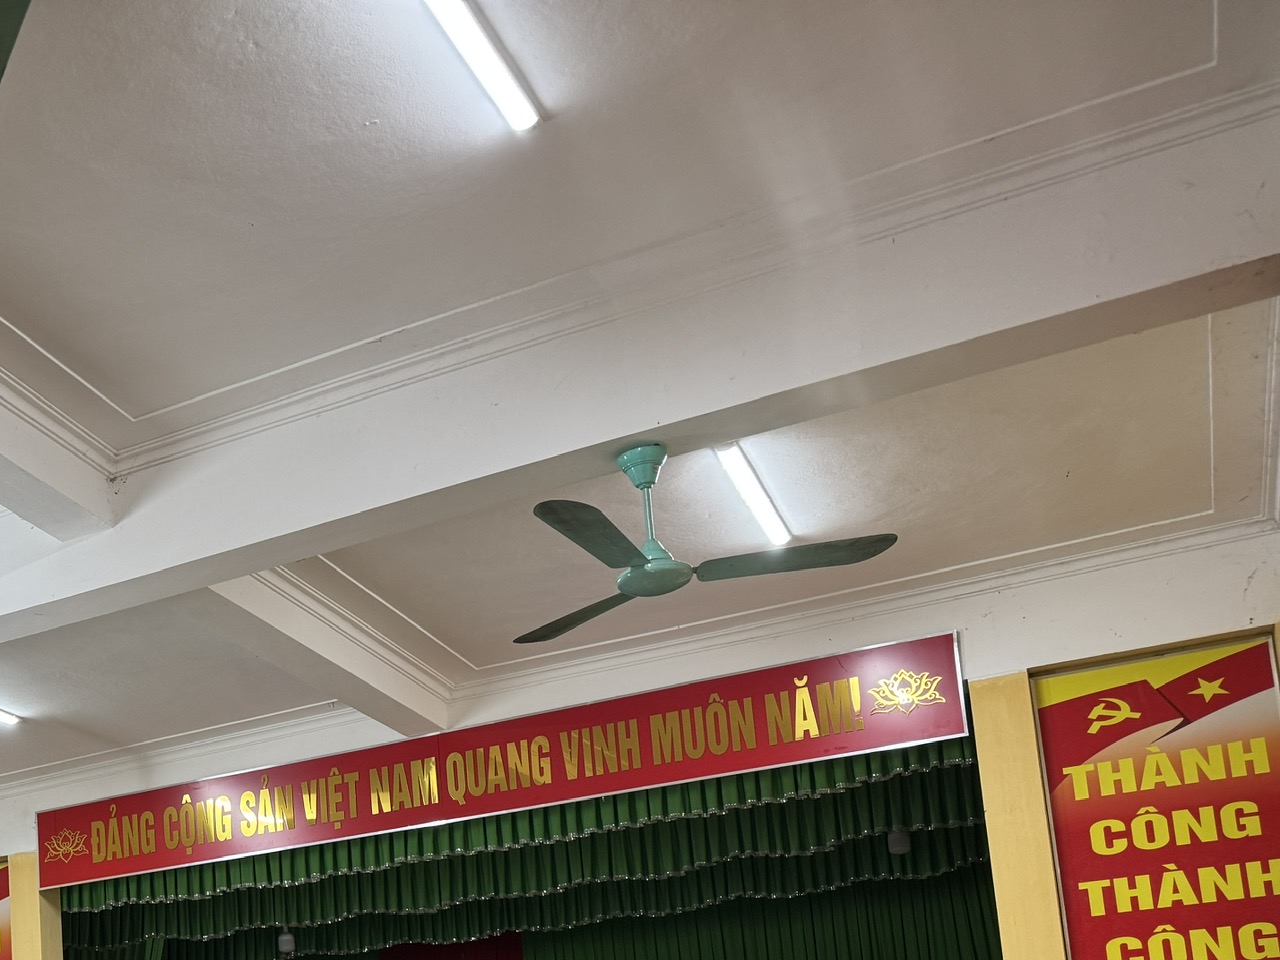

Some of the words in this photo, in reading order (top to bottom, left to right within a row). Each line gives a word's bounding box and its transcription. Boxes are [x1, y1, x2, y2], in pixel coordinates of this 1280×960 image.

[91, 803, 156, 863] ĐẢNG
[163, 793, 232, 855] CỘNG
[240, 774, 296, 838] SẢN
[301, 767, 359, 830] VIỆT
[369, 756, 439, 816] NAM
[446, 735, 552, 805] QUANG
[559, 718, 641, 780] VINH
[650, 693, 757, 766] MUÔN
[765, 675, 865, 746] NĂM!
[1062, 736, 1270, 801] THÀNH
[1089, 801, 1262, 856] CÔNG
[1078, 858, 1280, 917] THÀNH
